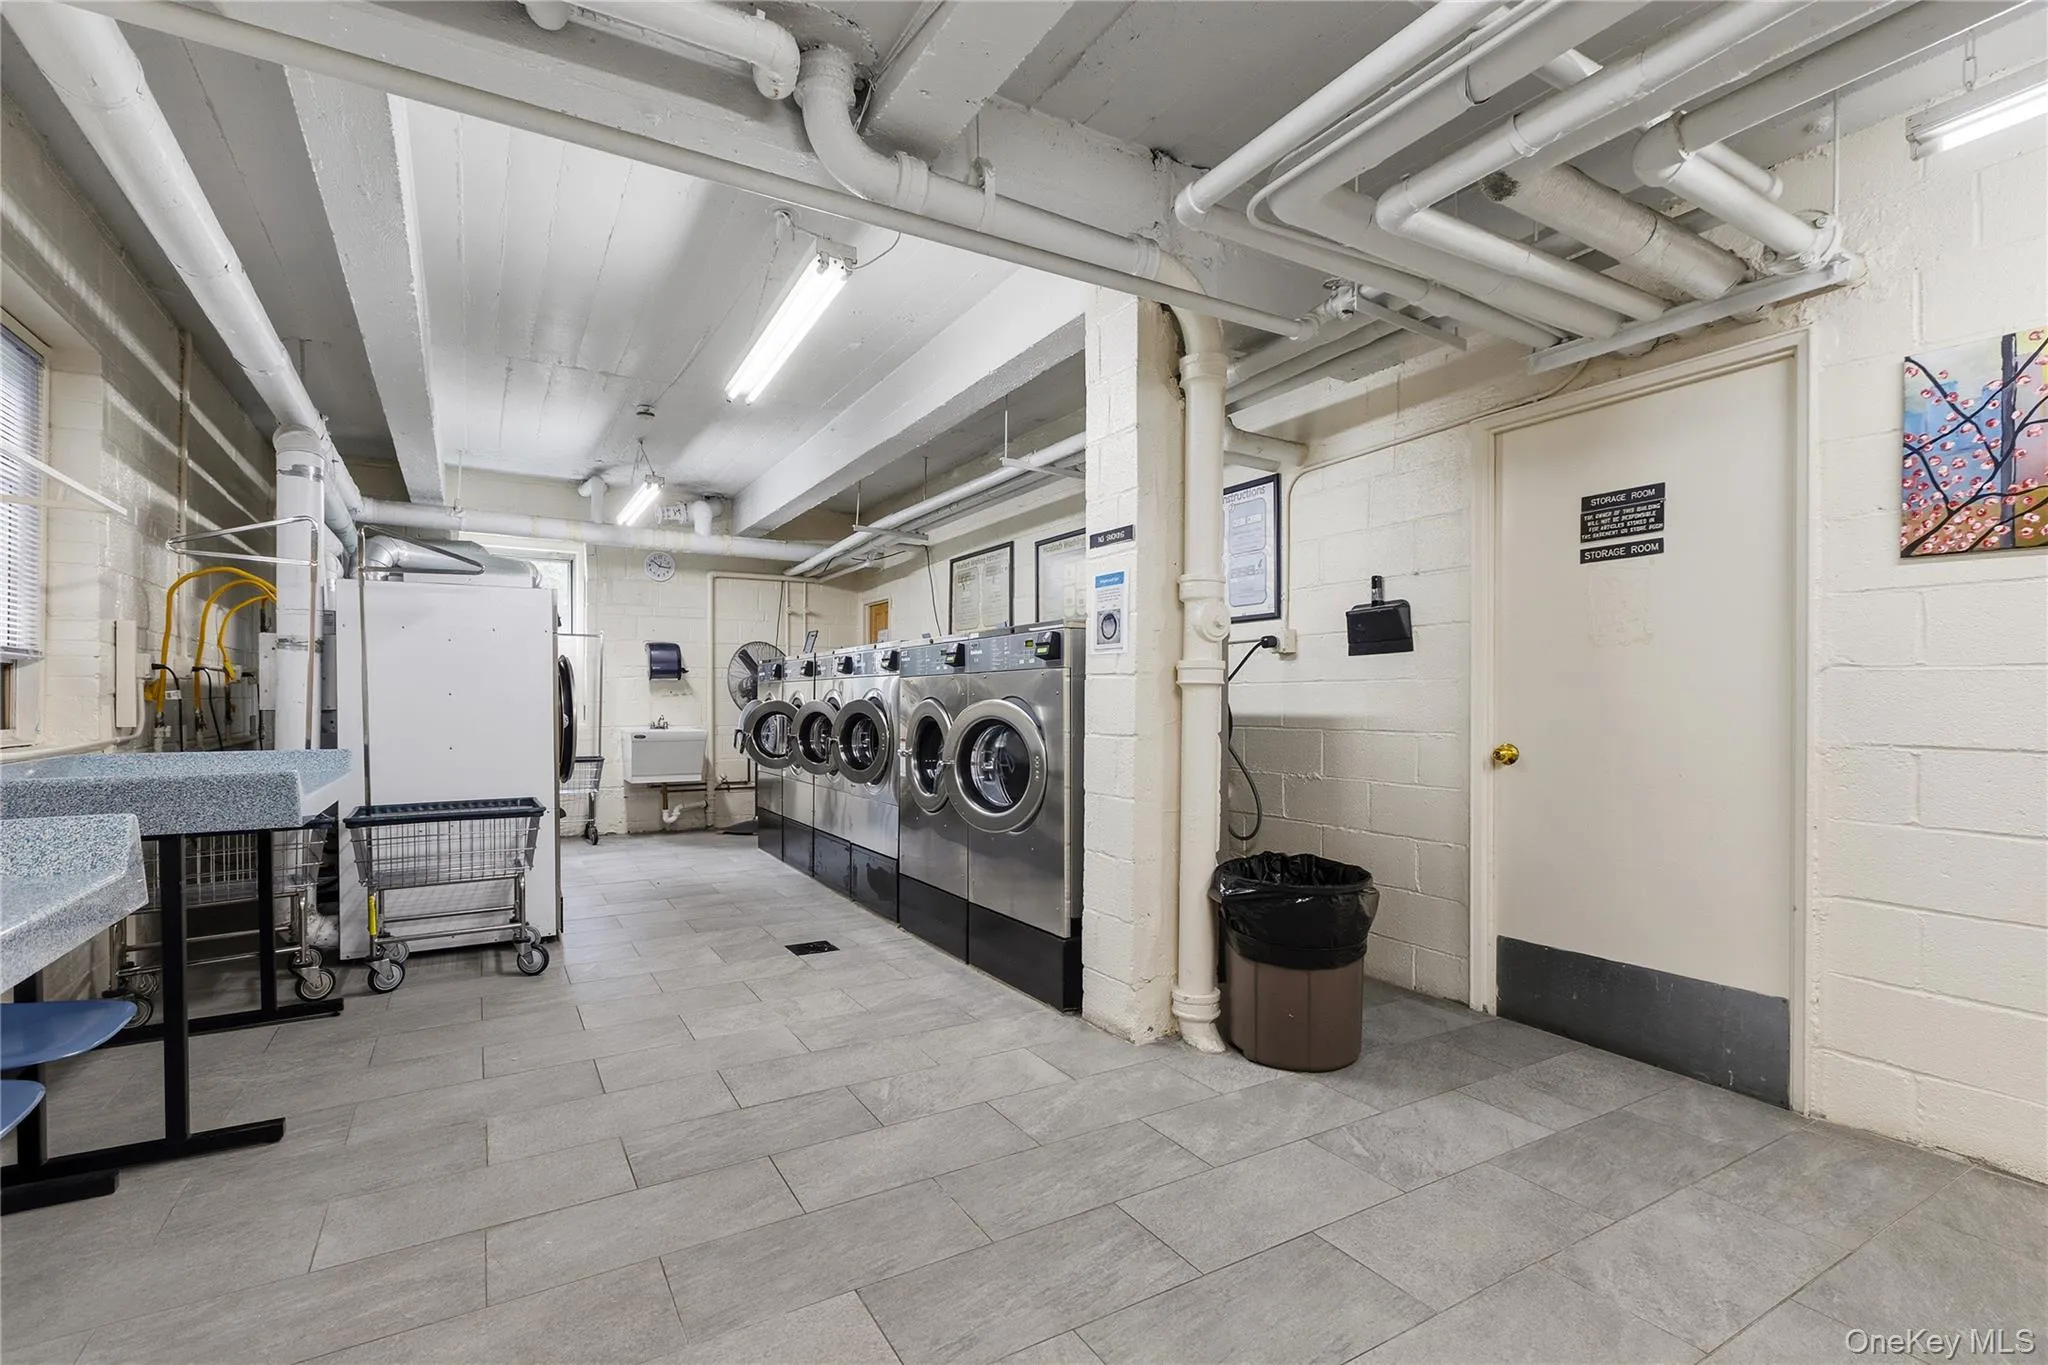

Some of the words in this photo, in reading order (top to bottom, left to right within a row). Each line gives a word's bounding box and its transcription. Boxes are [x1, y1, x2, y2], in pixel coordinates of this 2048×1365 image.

[1223, 486, 1266, 504] nstructions
[1590, 493, 1627, 507] STORAGE
[1631, 489, 1656, 500] ROOM
[1584, 546, 1626, 560] STORAGE
[1630, 542, 1659, 554] ROOM
